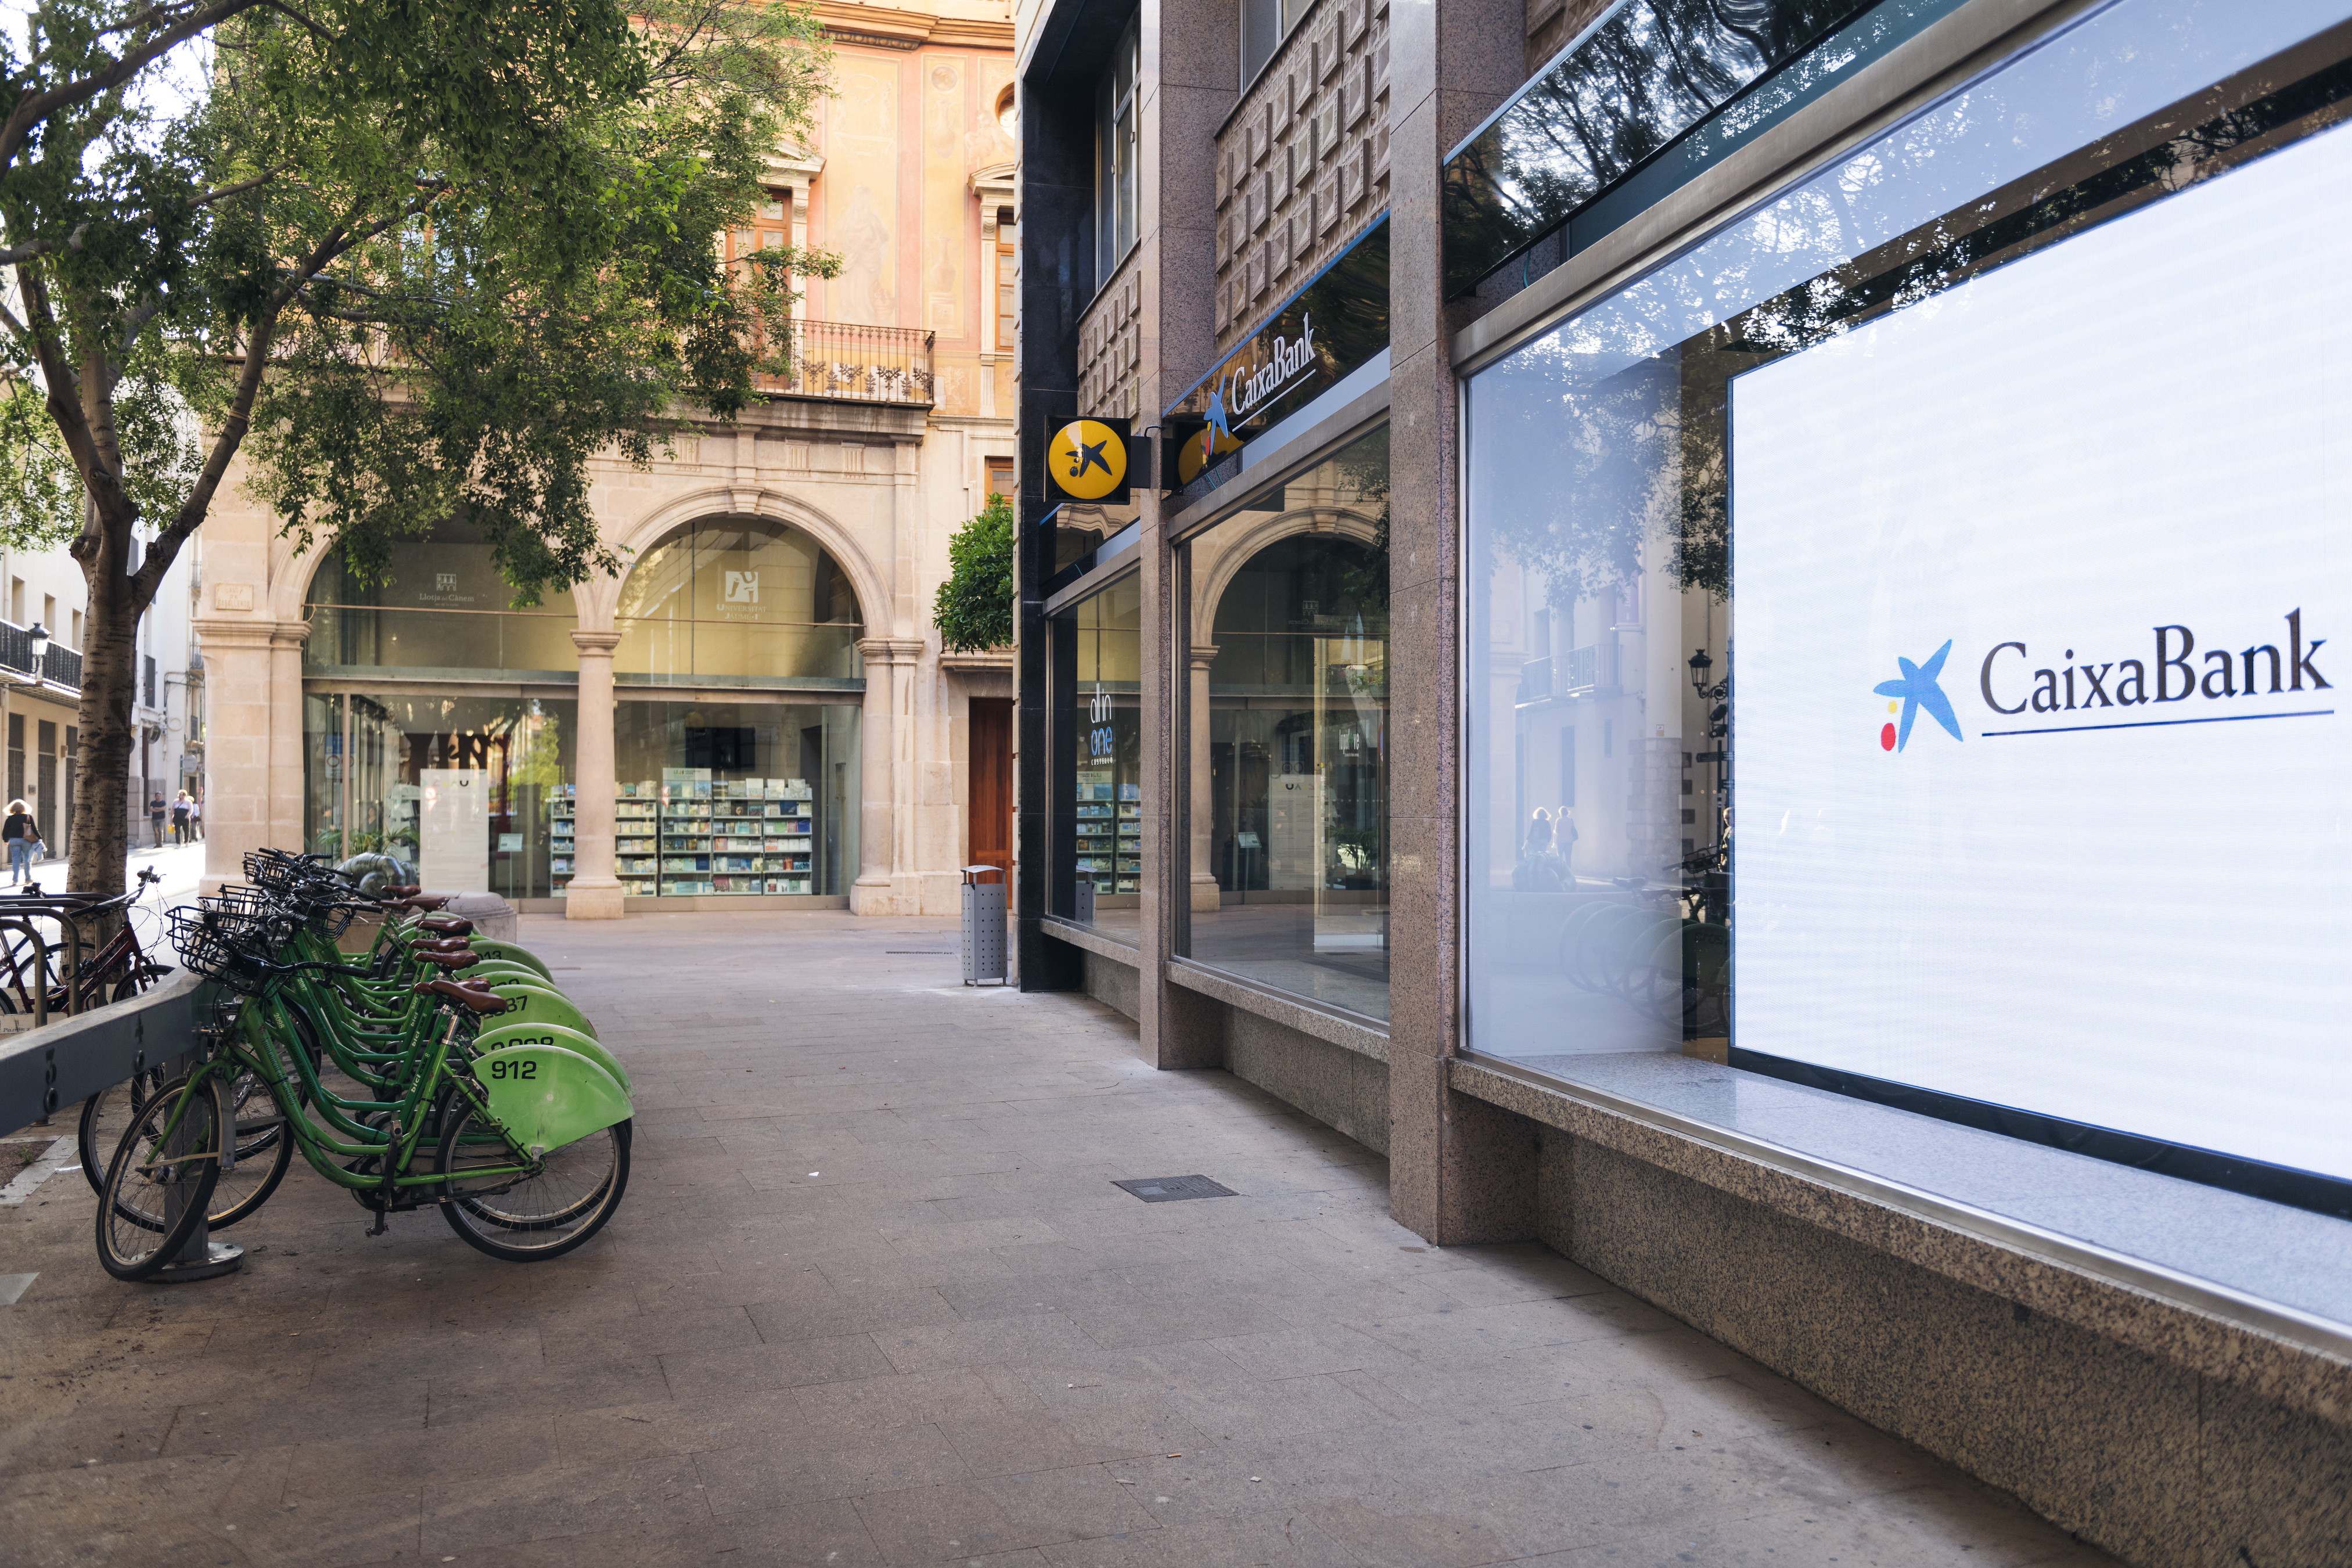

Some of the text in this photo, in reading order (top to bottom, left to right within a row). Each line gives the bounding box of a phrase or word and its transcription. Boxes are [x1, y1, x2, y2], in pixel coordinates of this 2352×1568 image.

[1232, 312, 1316, 415] CaixaBank
[419, 592, 441, 602] Llotja
[448, 594, 474, 602] Cànem
[717, 603, 767, 613] UNIVERSITAT
[1980, 607, 2333, 715] CaixaBank
[1090, 682, 1112, 724] all in
[1091, 726, 1113, 756] one
[1091, 754, 1113, 766] CASTELLÓ
[297, 977, 307, 991] 2087
[274, 1012, 285, 1029] 2098
[260, 1037, 282, 1073] Ajuntament
[281, 1079, 298, 1106] Castelló
[298, 1064, 305, 1072] de
[492, 1060, 537, 1080] 912
